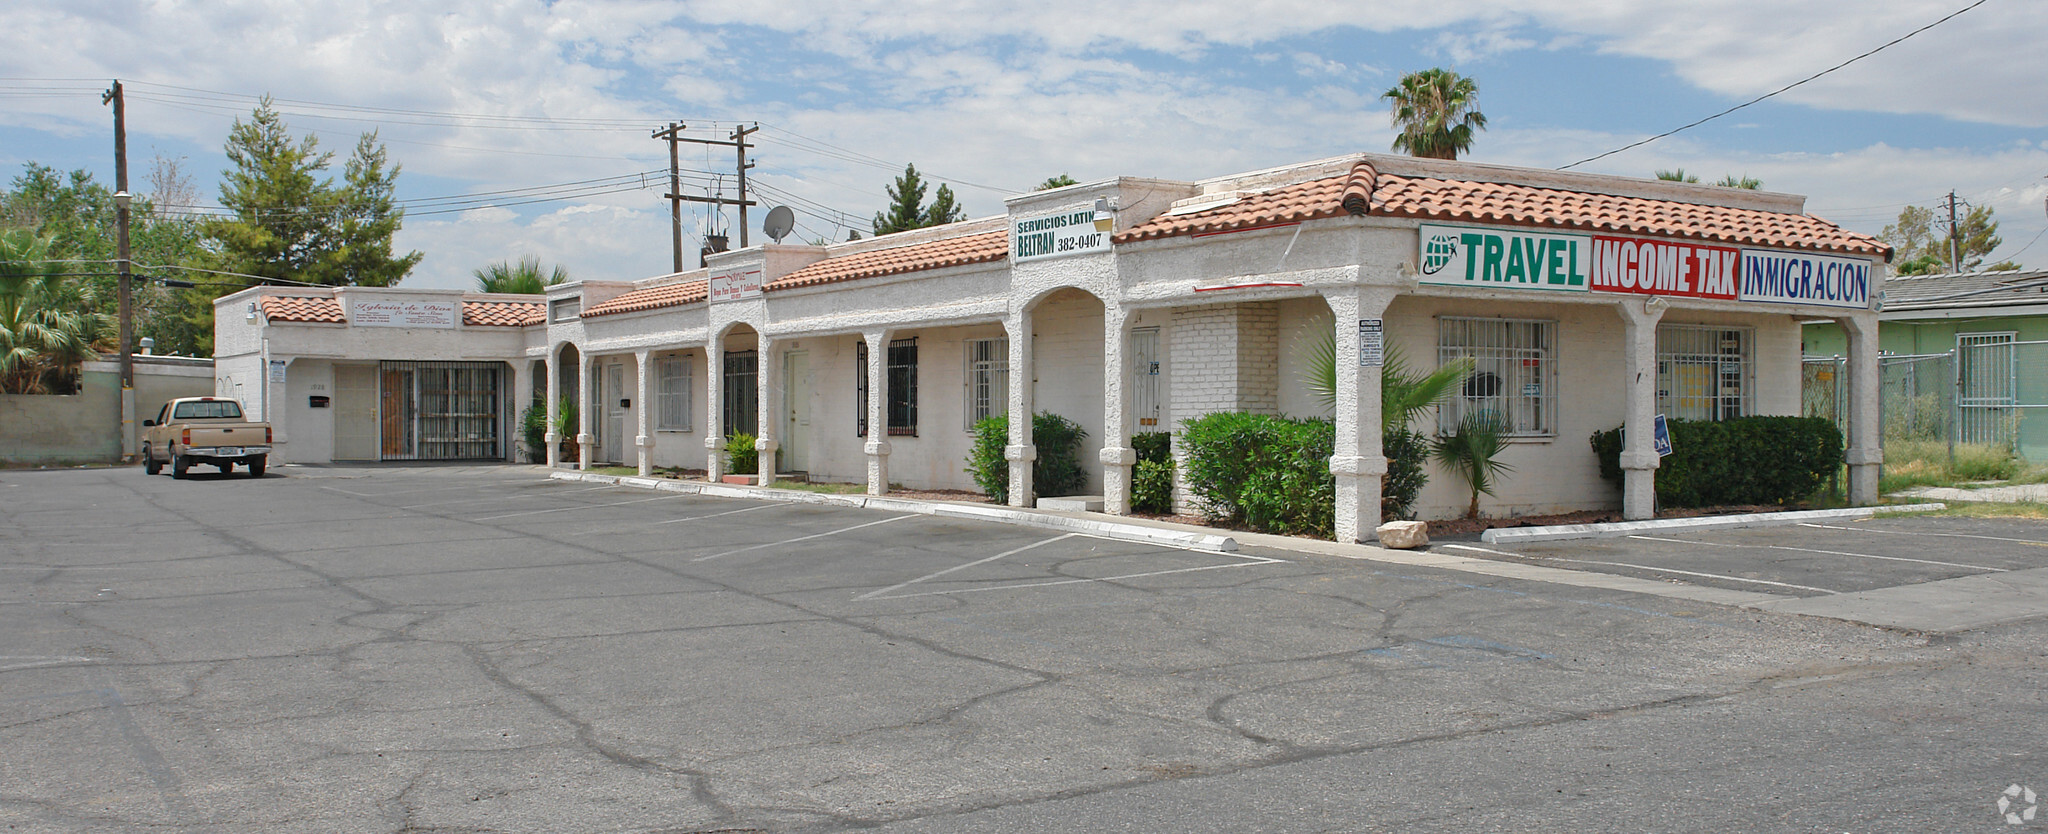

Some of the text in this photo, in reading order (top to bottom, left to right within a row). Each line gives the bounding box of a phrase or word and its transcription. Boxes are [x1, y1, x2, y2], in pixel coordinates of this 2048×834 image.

[1017, 215, 1067, 234] SERVICIOS
[1017, 231, 1102, 258] BELTRAN 382-0407
[1460, 233, 1585, 286] TRAVEL
[1592, 239, 1737, 296] INCOME TAX
[1743, 255, 1869, 303] INMIGRACION
[424, 304, 452, 312] Dios
